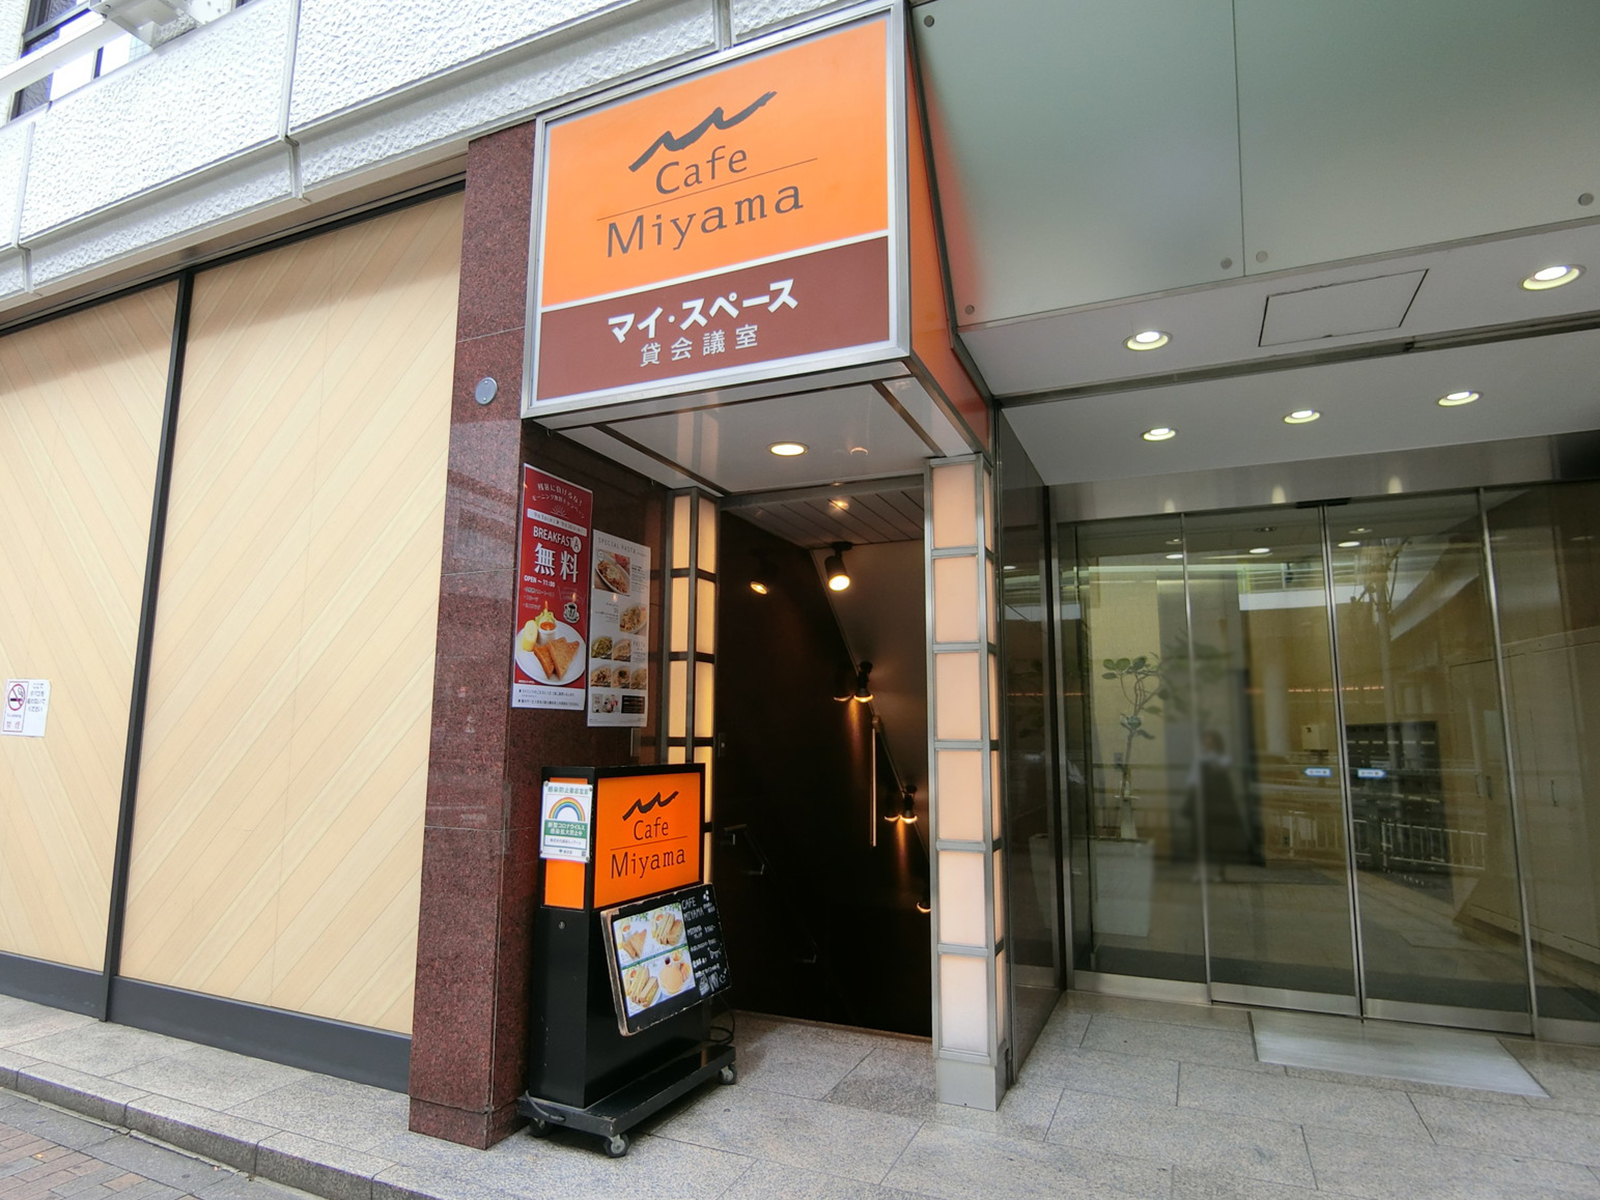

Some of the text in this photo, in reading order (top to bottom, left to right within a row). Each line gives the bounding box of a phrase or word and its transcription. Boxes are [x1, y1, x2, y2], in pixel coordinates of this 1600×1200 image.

[656, 145, 748, 195] Cafe
[607, 185, 803, 258] Miyama
[608, 278, 799, 344] マイ・スペース
[640, 324, 759, 367] 貸会議室
[533, 525, 573, 547] BREAKFAST
[523, 575, 537, 584] OPEN
[534, 543, 579, 583] 無料
[633, 816, 669, 841] Cafe
[610, 848, 686, 879] Miyama
[681, 896, 697, 910] CAFE
